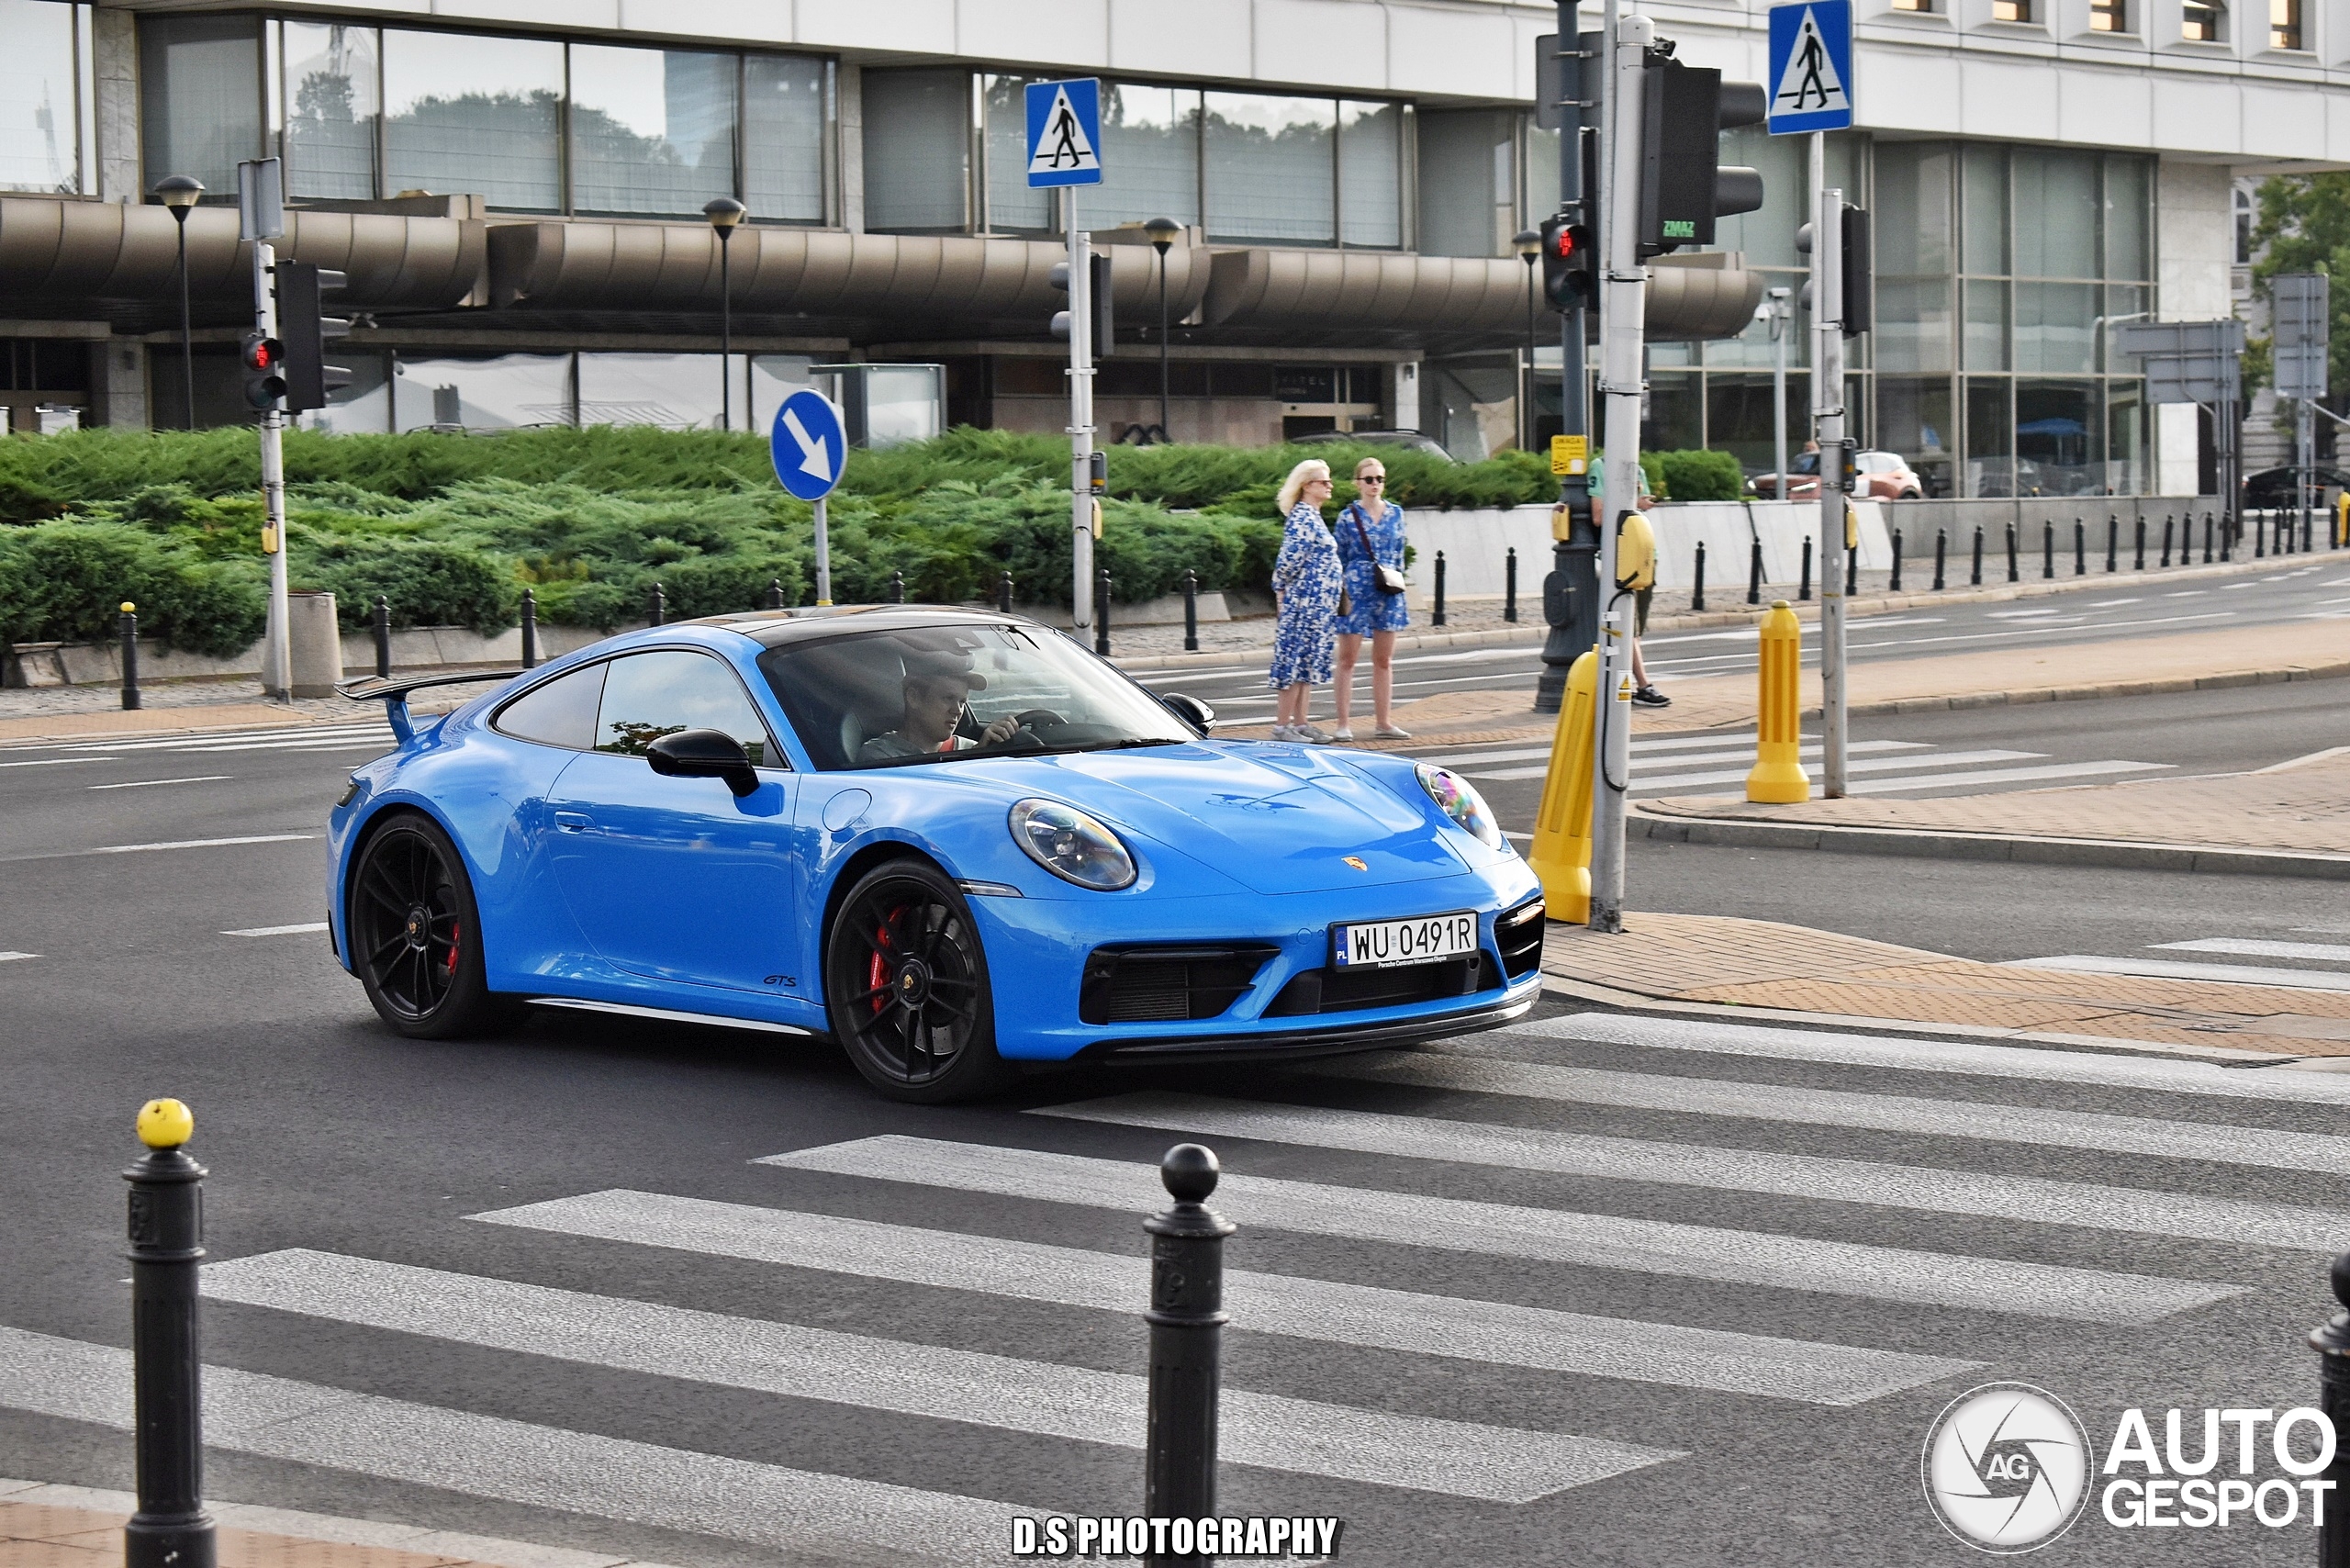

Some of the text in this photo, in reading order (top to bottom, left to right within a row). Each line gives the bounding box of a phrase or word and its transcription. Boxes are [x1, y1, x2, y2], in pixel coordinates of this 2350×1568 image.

[1663, 220, 1695, 232] ZMAZ
[1354, 917, 1472, 960] WU 0491R
[1337, 950, 1348, 960] PL
[763, 974, 797, 987] GTS
